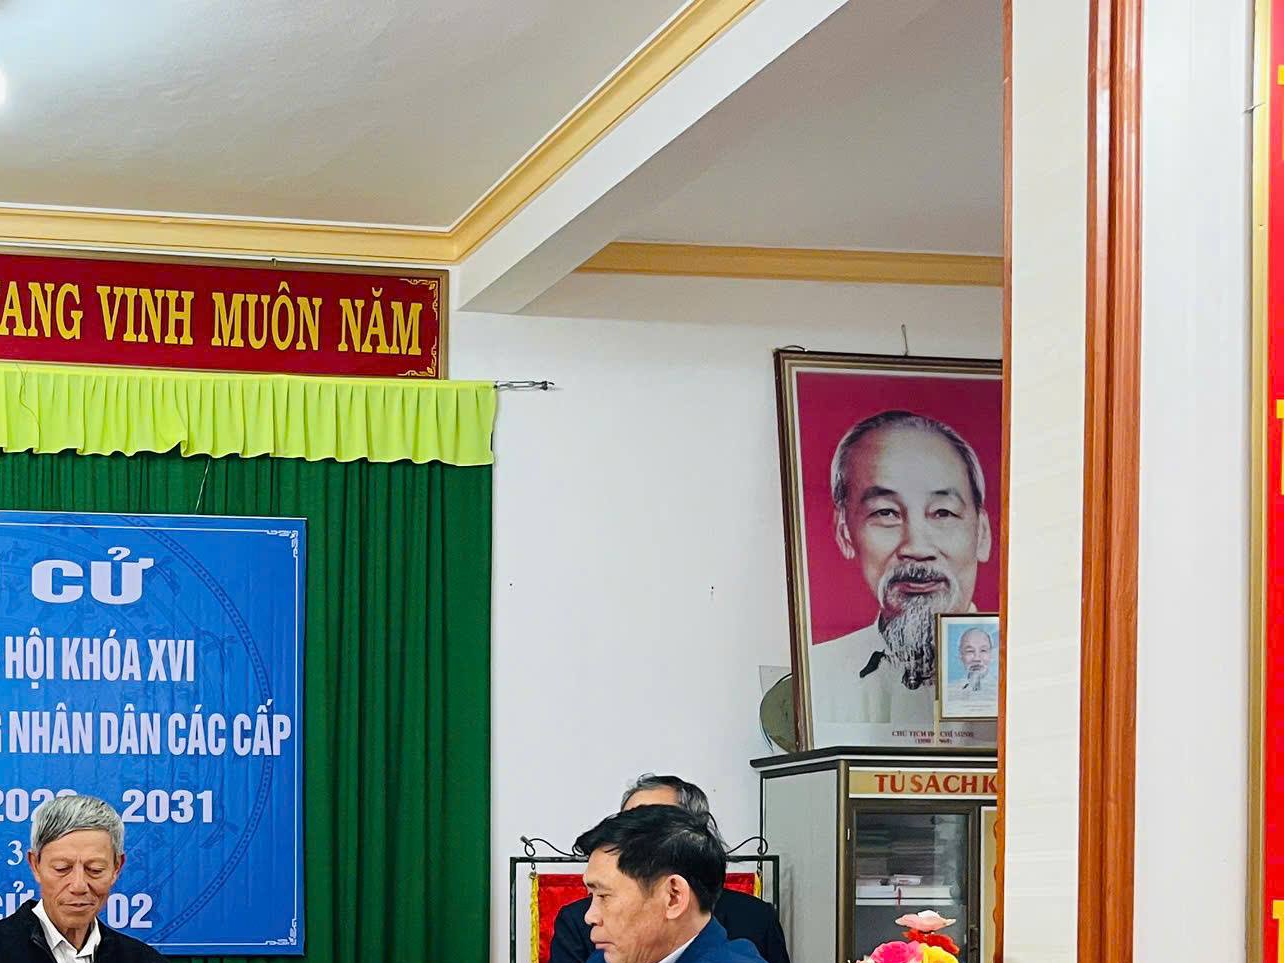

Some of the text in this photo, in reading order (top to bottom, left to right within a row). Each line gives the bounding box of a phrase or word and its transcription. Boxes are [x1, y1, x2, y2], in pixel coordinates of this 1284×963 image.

[97, 284, 195, 346] VINH
[211, 281, 321, 352] MUÔN
[338, 287, 423, 356] NĂM
[31, 546, 155, 605] CỬ
[5, 626, 55, 689] HỘI
[61, 629, 142, 681] KHÓA
[147, 639, 195, 682] XVI
[9, 702, 93, 754] NHÂN
[99, 703, 161, 755] DÂN
[167, 704, 226, 756] CÁC
[232, 698, 292, 756] CẤP
[874, 770, 905, 793] TỦ
[910, 771, 978, 793] SÁCH
[121, 789, 213, 824] 2031
[7, 840, 24, 866] 3
[107, 893, 153, 929] 02
